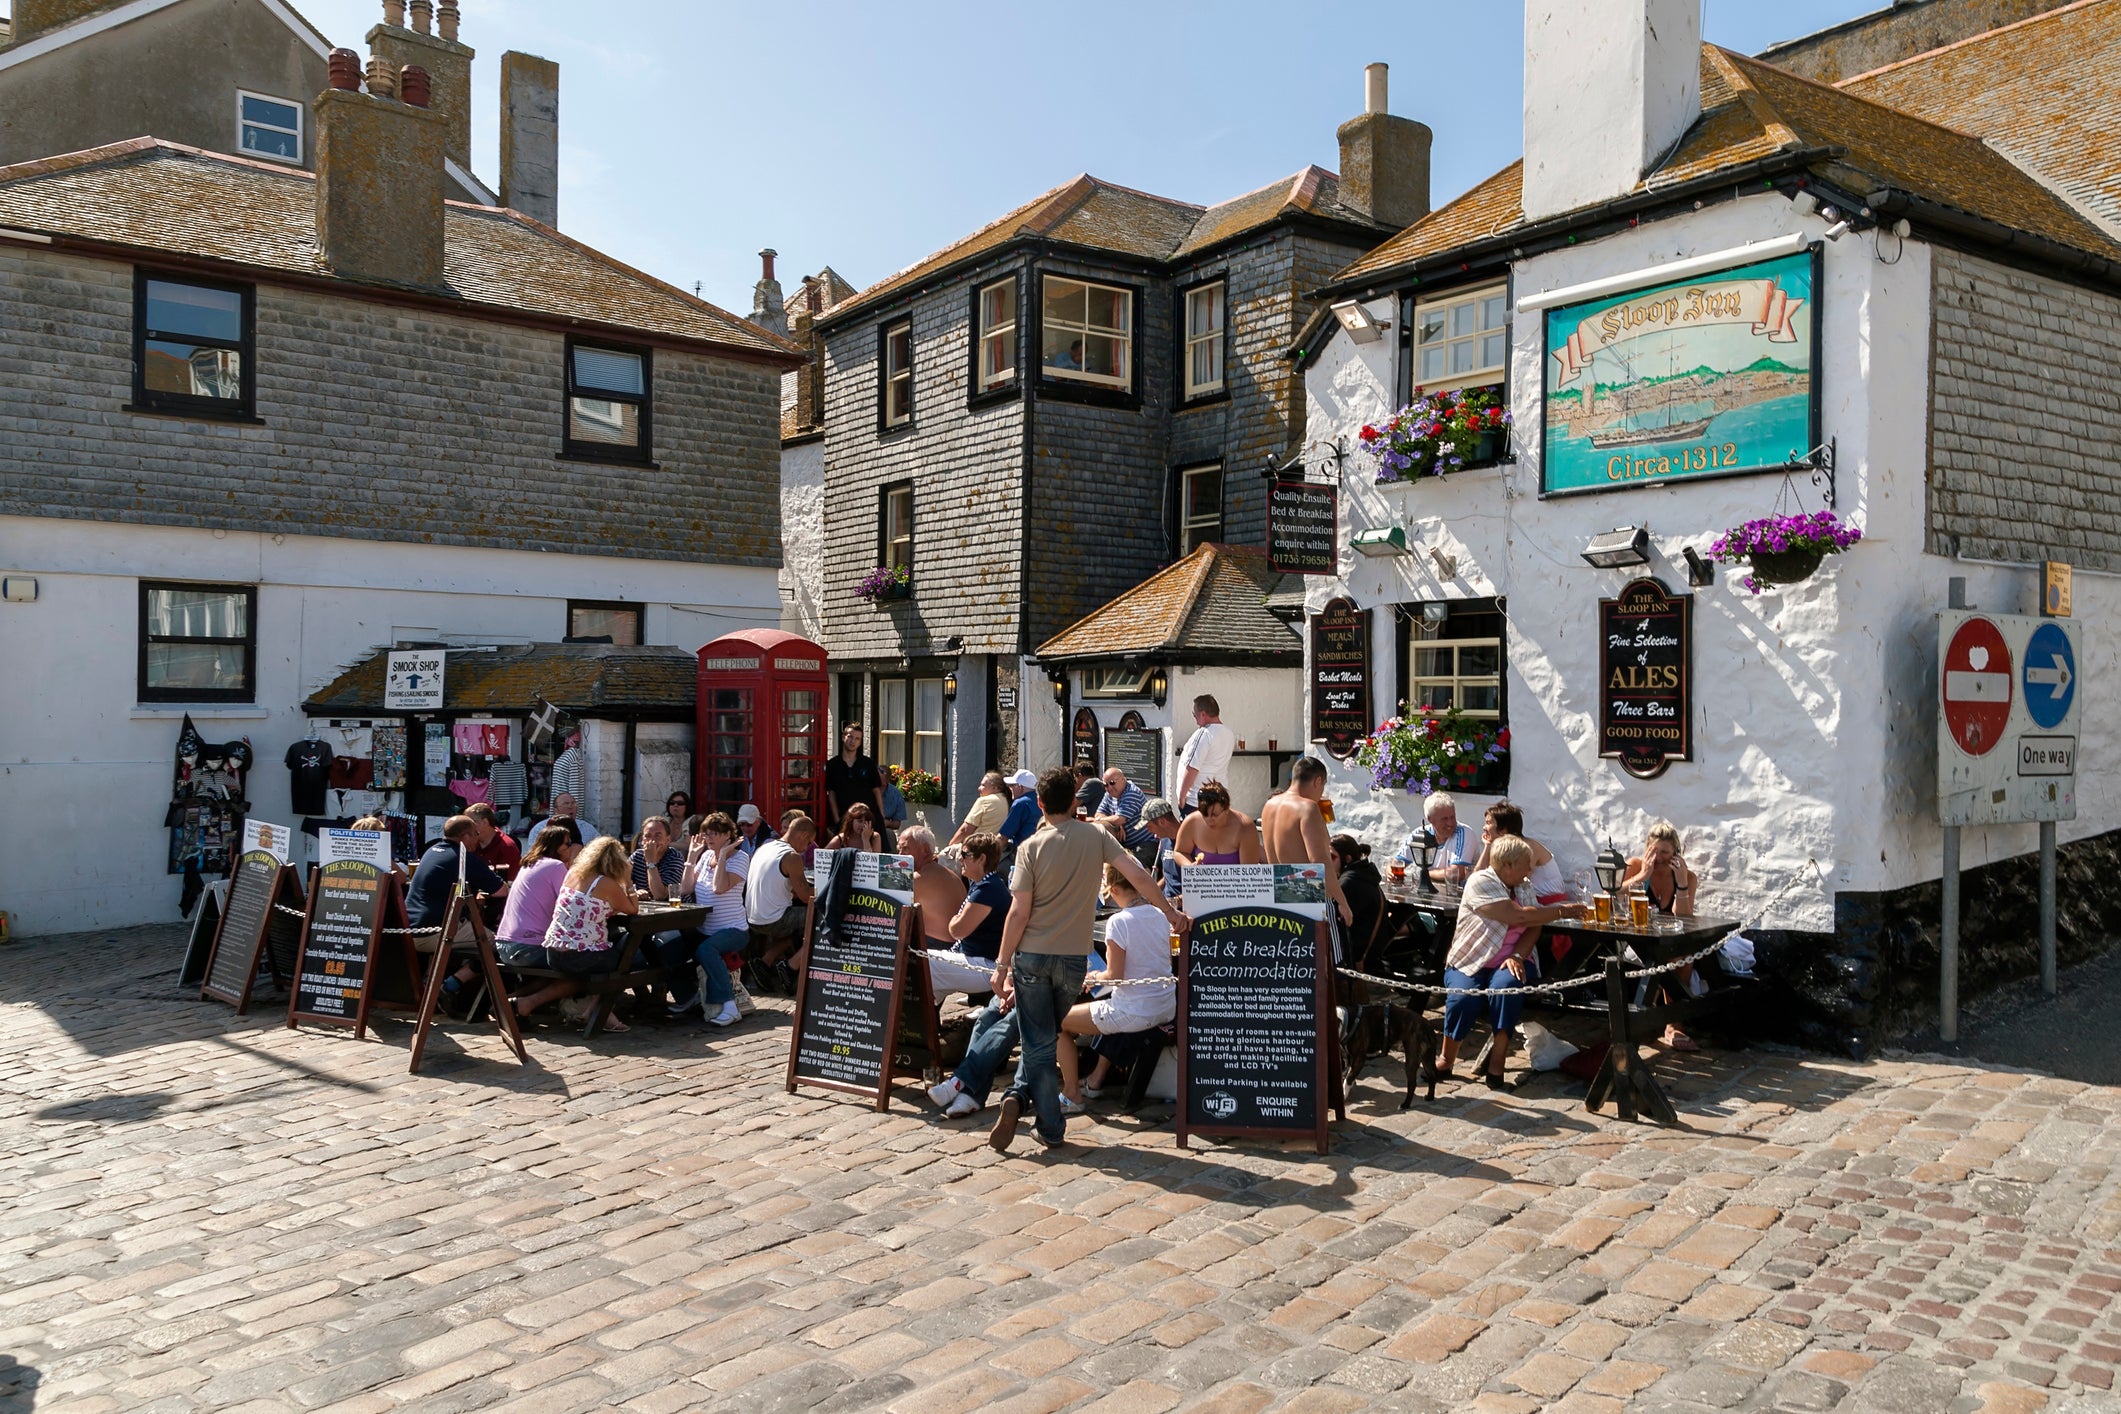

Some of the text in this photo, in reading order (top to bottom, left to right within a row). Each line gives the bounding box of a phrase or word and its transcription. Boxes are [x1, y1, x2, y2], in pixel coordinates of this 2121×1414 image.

[1601, 289, 1741, 343] Sloop Inn
[1273, 490, 1331, 504] Quality Ensuite
[1271, 506, 1333, 520] Bed & Breakfast
[1271, 522, 1333, 535] Accommodation
[1275, 539, 1329, 550] enquire within
[1273, 553, 1299, 564] 01736
[1633, 594, 1654, 604] THE
[1334, 609, 1347, 617] THE
[1618, 602, 1670, 614] SLOOP INN
[1323, 616, 1357, 625] SLOOP INN
[1636, 618, 1649, 631] A
[1327, 632, 1353, 642] MEALS
[1609, 634, 1678, 649] Fine Selection
[1336, 642, 1343, 650] &
[1318, 651, 1363, 661] SANDWICHES
[1637, 650, 1648, 666] of
[392, 661, 439, 672] SMOCK SHOP
[710, 659, 758, 668] TELEPHONE
[776, 659, 818, 669] TELEPHONE
[1318, 671, 1363, 682] Basket Meals
[1609, 665, 1678, 688] ALES
[1325, 691, 1355, 701] Local Fish
[1331, 700, 1349, 709] Dishes
[1613, 701, 1675, 717] Three Bars
[1319, 720, 1363, 730] BAR SNACKS
[1607, 727, 1680, 739] GOOD FOOD
[2023, 746, 2071, 767] One way
[244, 853, 254, 863] THE
[325, 861, 377, 878] THE SLOOP INN
[1184, 868, 1272, 876] THE SUNDECK at THE SLOOP INN
[878, 900, 896, 917] INN
[1200, 914, 1305, 936] THE SLOOP INN
[1190, 937, 1316, 959] Bed & Breakfast
[842, 964, 862, 974] £4.95
[1189, 961, 1317, 980] Accommodation
[1207, 985, 1227, 994] Sloop
[1228, 985, 1239, 993] Inn
[1254, 987, 1269, 995] very
[1271, 986, 1312, 994] comfortable
[1201, 993, 1227, 1001] Double,
[1258, 995, 1279, 1003] family
[1233, 1002, 1243, 1010] for
[1244, 1002, 1257, 1010] bed
[1273, 1003, 1306, 1011] breakfast
[1190, 1010, 1244, 1018] accommodation
[1245, 1011, 1284, 1020] throughout
[1297, 1013, 1314, 1021] year
[1188, 1026, 1202, 1034] The
[1203, 1027, 1234, 1036] majority
[1285, 1029, 1316, 1037] en-suite
[1215, 1035, 1235, 1043] have
[1236, 1036, 1270, 1045] glorious
[1272, 1037, 1305, 1045] harbour
[832, 1045, 851, 1056] £9.95
[1190, 1043, 1213, 1051] views
[1266, 1045, 1299, 1055] heating,
[1196, 1052, 1308, 1063] and coffee making facilities
[1260, 1062, 1278, 1070] TV's
[1195, 1077, 1225, 1086] Limited
[1227, 1078, 1259, 1088] Parking
[1270, 1080, 1308, 1089] available
[1256, 1096, 1298, 1107] ENQUIRE
[1260, 1107, 1294, 1118] WITHIN
